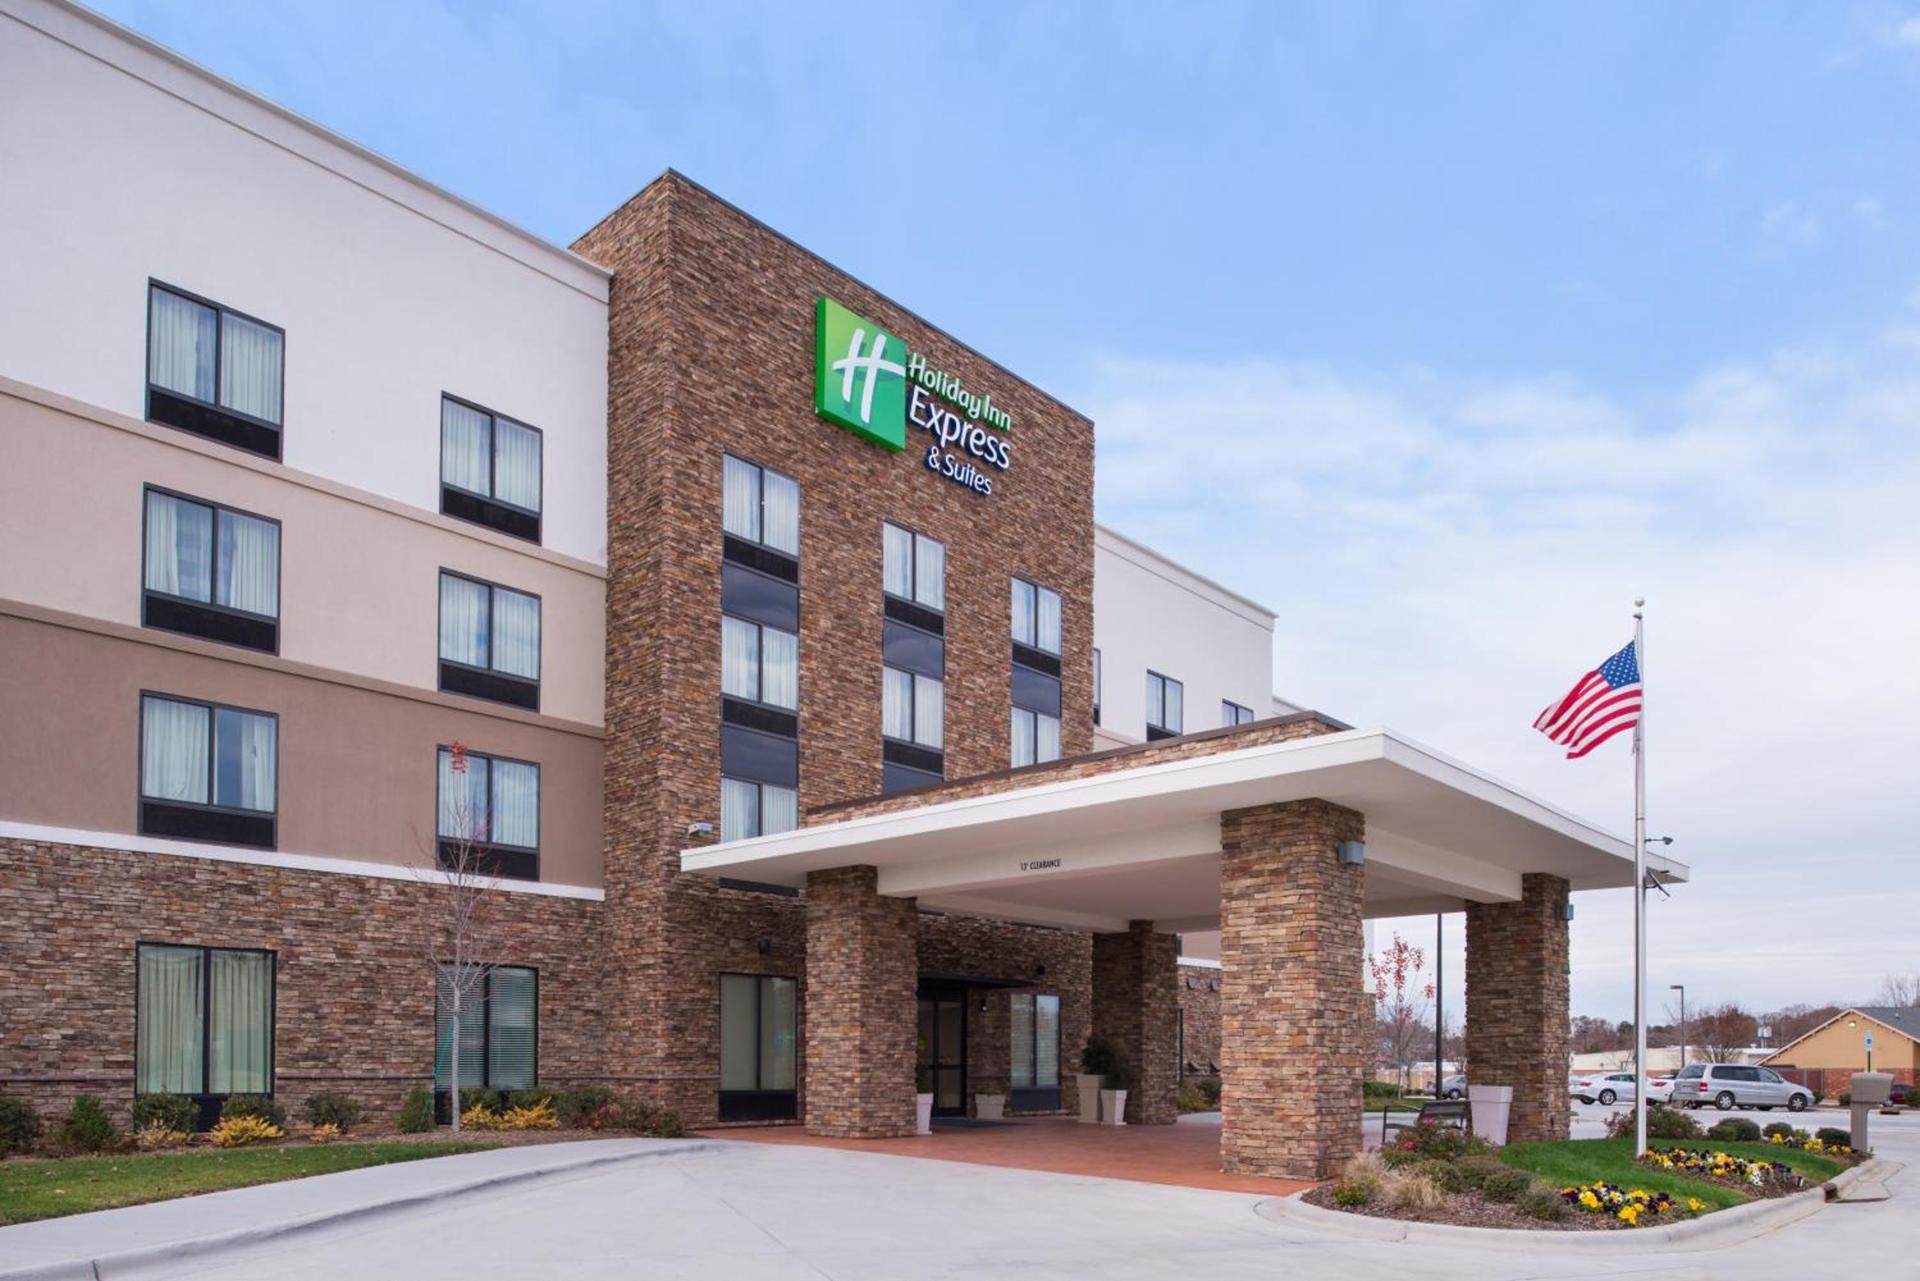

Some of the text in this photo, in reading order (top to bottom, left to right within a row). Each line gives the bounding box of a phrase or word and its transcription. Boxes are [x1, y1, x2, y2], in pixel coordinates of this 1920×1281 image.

[908, 352, 1011, 431] Holiday Inn
[909, 385, 1010, 469] Express
[928, 446, 992, 495] & Suites
[1030, 859, 1061, 870] CLEARANCE
